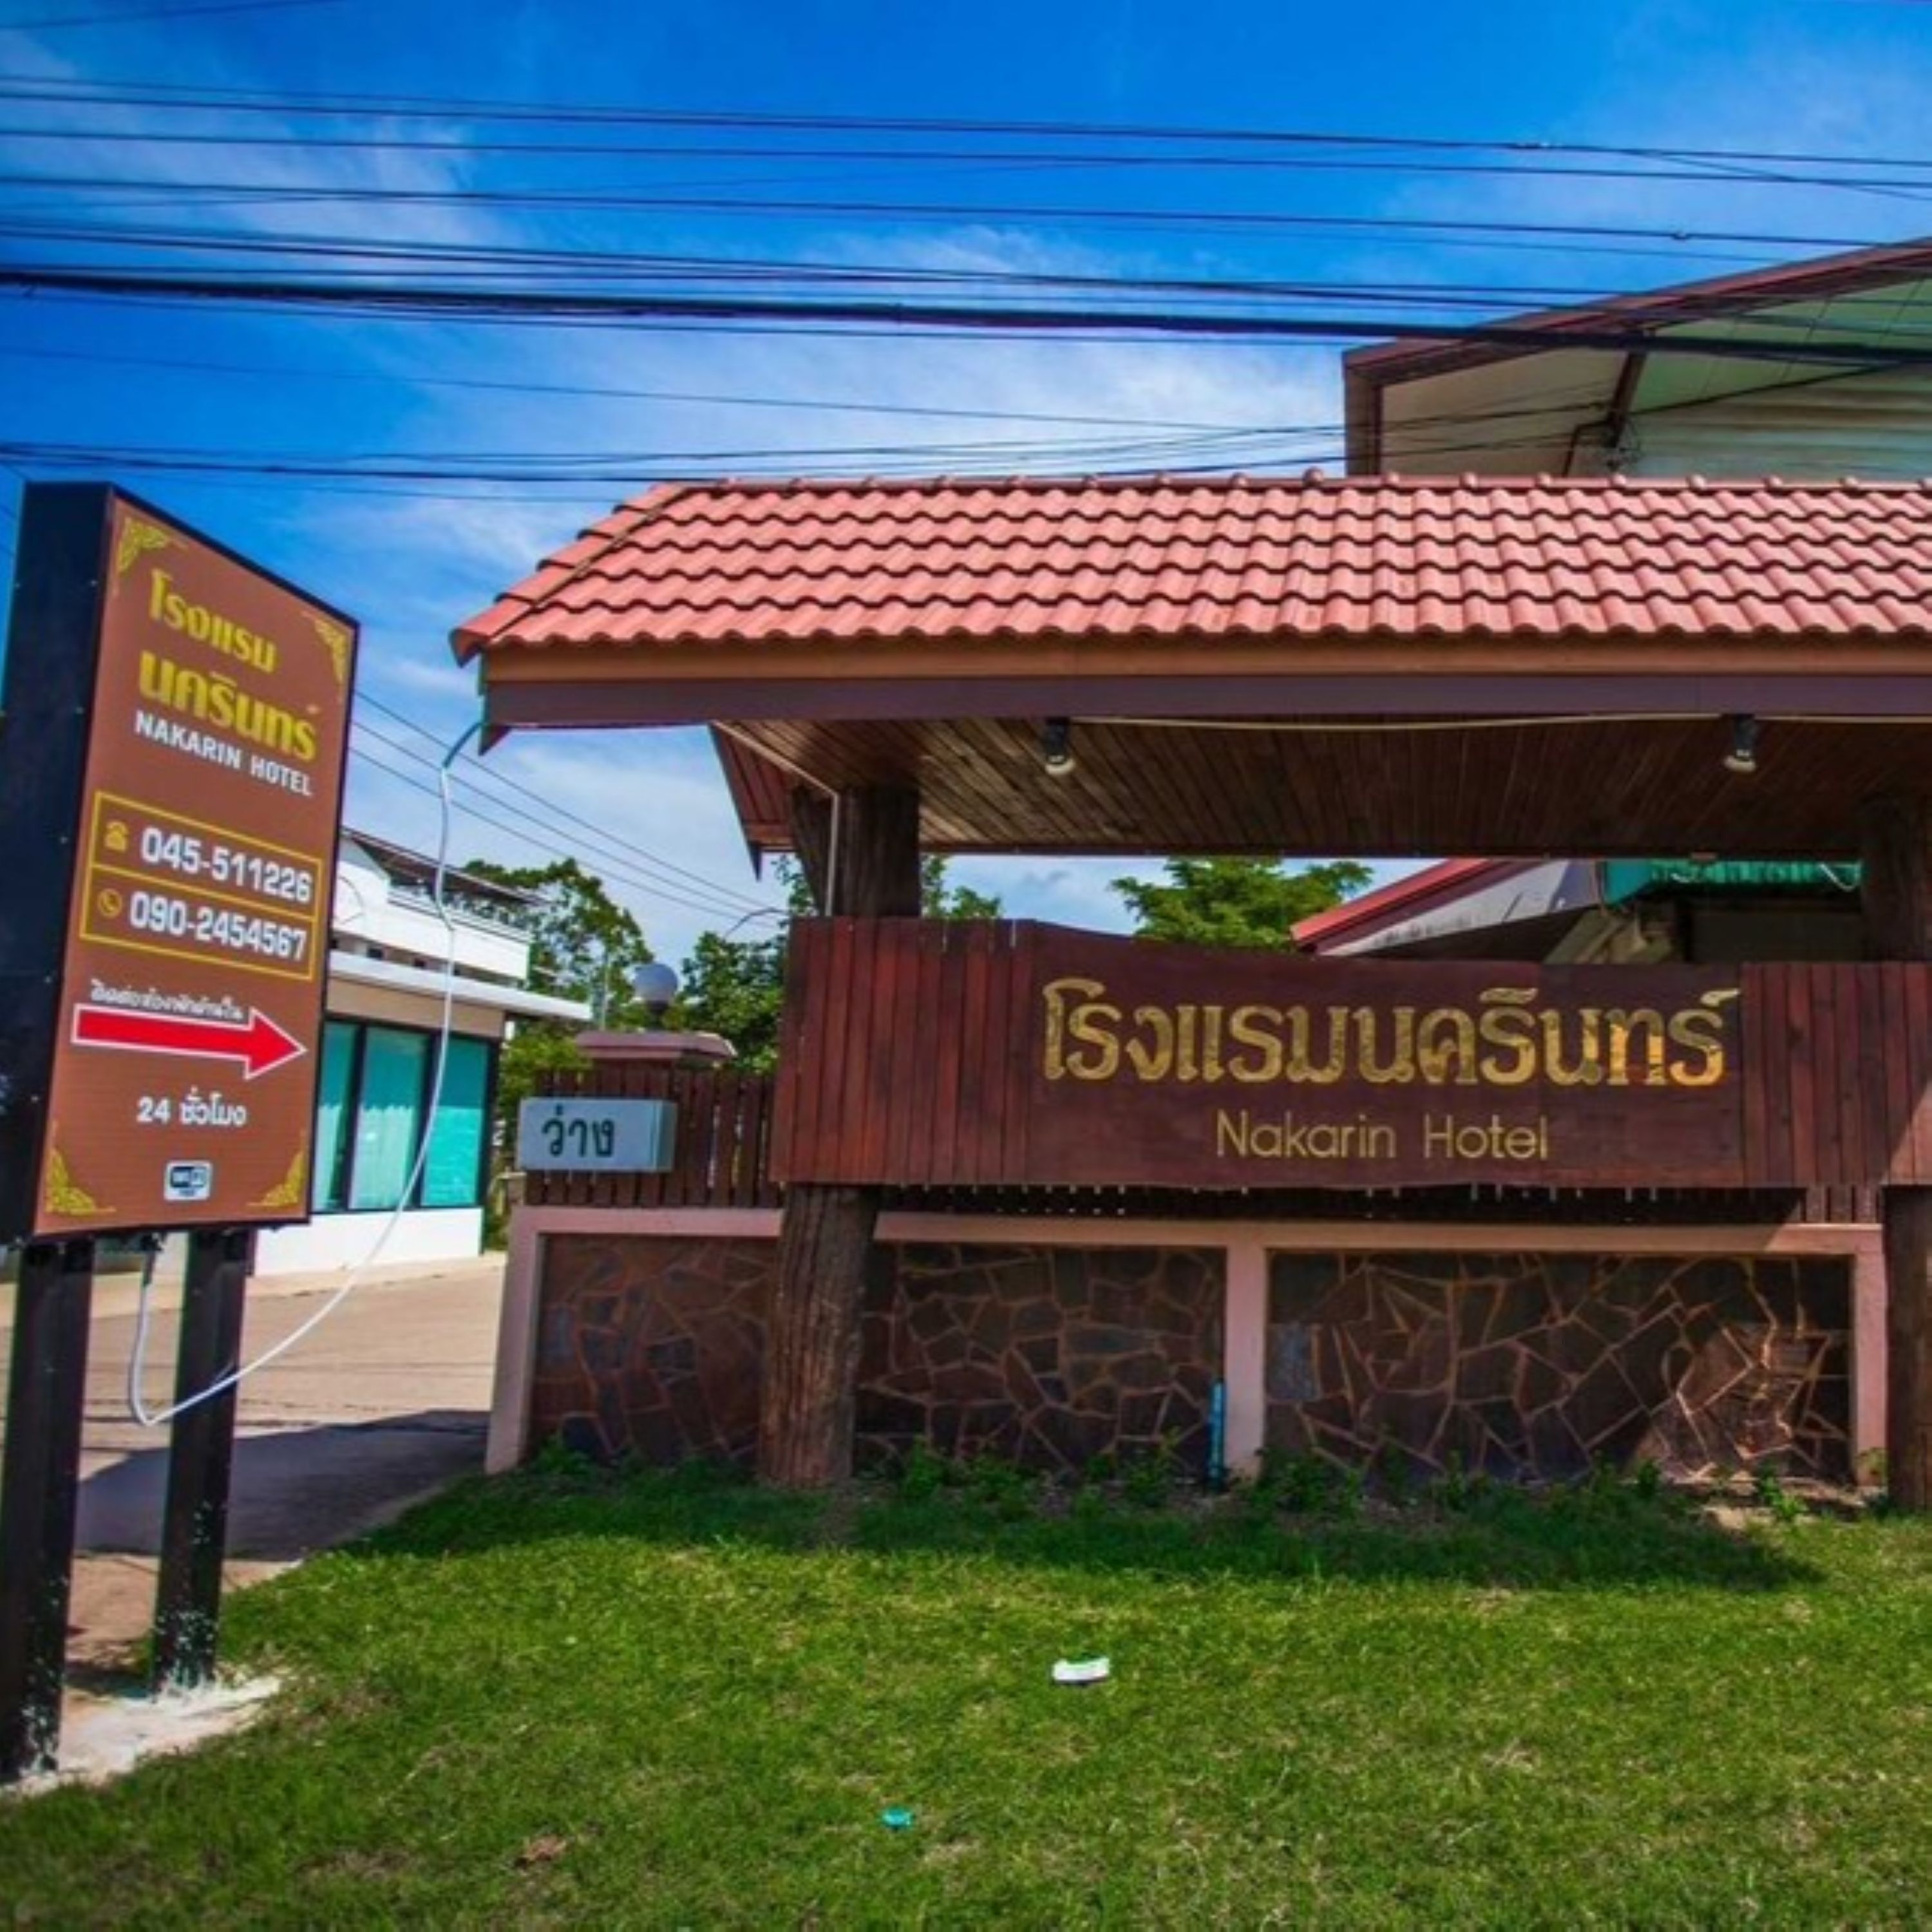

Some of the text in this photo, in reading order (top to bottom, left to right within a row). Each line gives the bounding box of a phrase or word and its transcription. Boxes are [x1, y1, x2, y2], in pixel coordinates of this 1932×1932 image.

[149, 567, 277, 674] โรงแรม
[134, 710, 313, 797] NAKARIN HOTEL
[140, 826, 312, 903] 045-511226
[129, 891, 307, 961] 090-2454567
[1041, 976, 1741, 1086] โรงแรมนครินทร์
[137, 1084, 247, 1127] 24 ชั่วโมง
[540, 1102, 614, 1157] ว่าง
[1217, 1110, 1547, 1160] Nakarin Hotel
